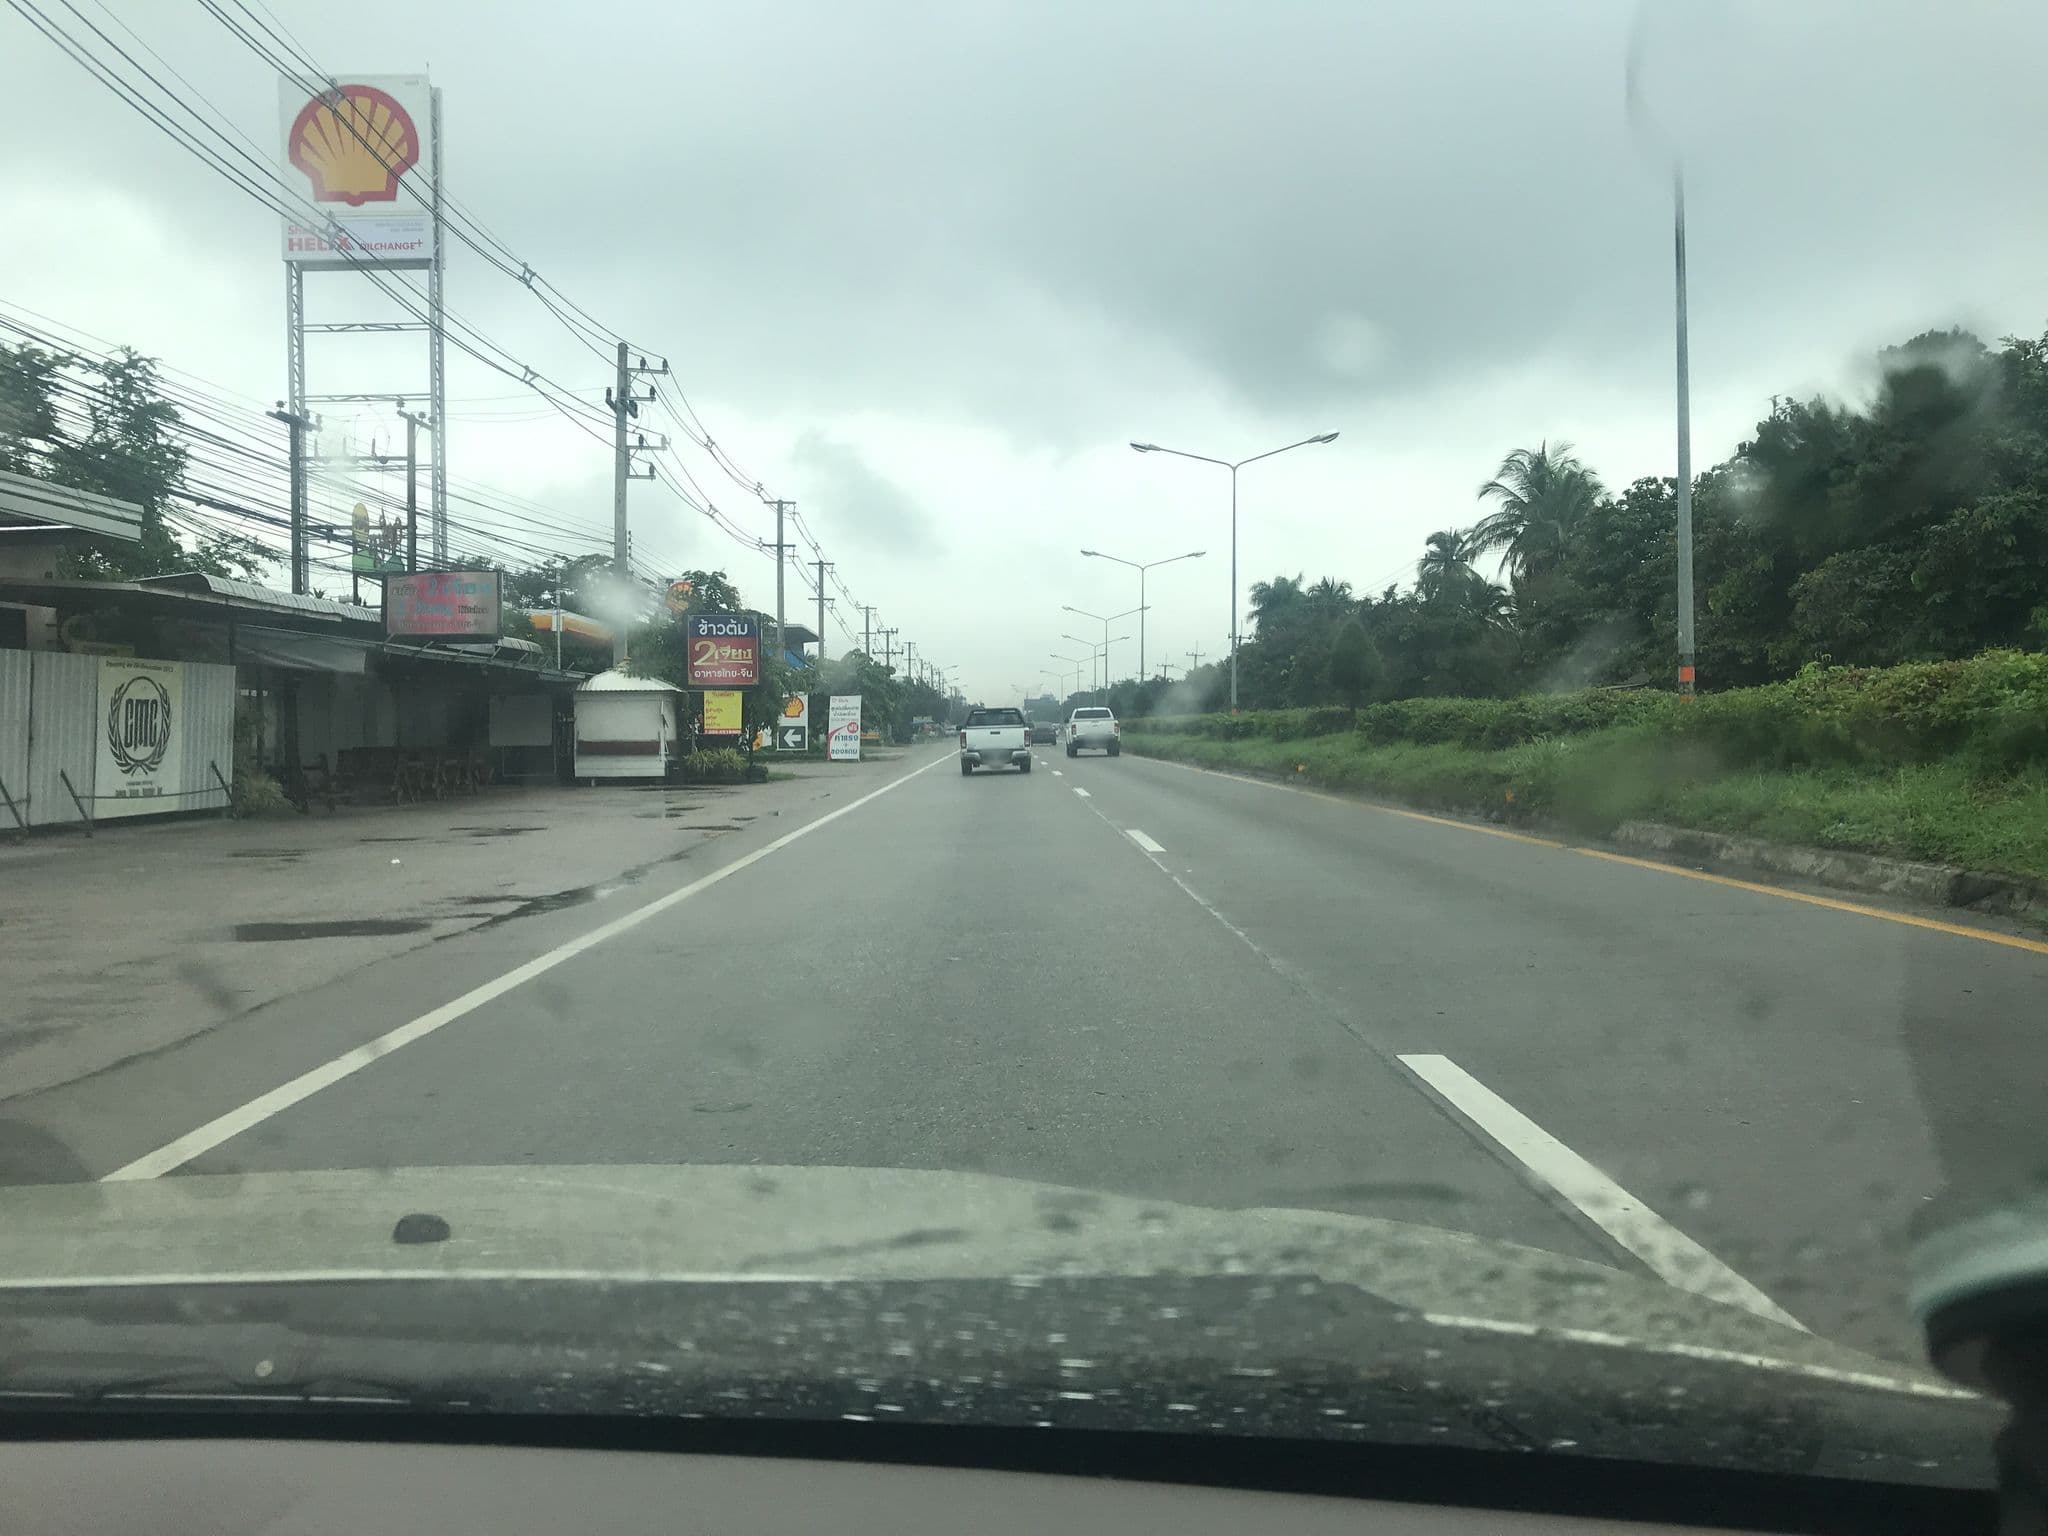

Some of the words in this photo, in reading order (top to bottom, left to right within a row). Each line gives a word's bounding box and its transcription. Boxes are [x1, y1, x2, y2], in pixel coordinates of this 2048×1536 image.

[288, 237, 352, 251] HELX
[698, 618, 748, 636] ข้าวต้ม
[694, 667, 753, 678] อาหารไทย-จีน
[124, 698, 158, 752] CMC
